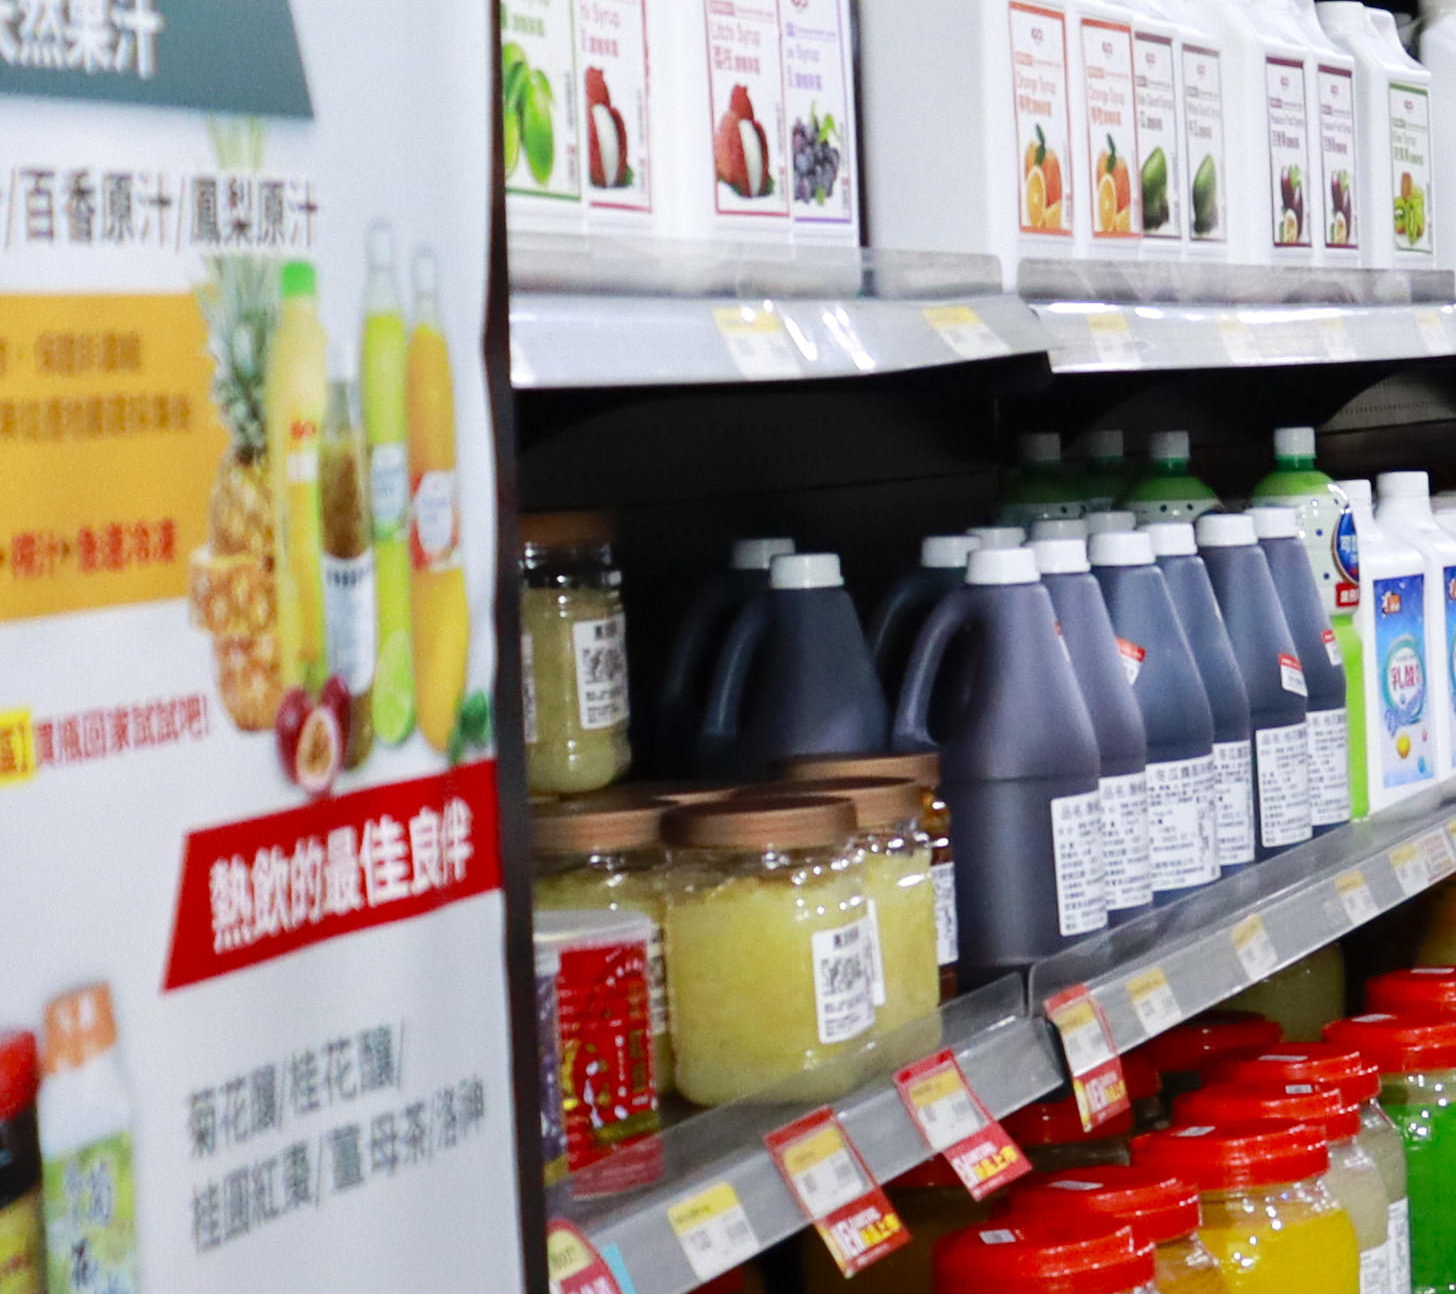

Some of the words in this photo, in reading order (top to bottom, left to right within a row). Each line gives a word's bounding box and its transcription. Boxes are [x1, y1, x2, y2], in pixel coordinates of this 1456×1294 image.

[209, 797, 474, 955] 熱飲的最佳良伴
